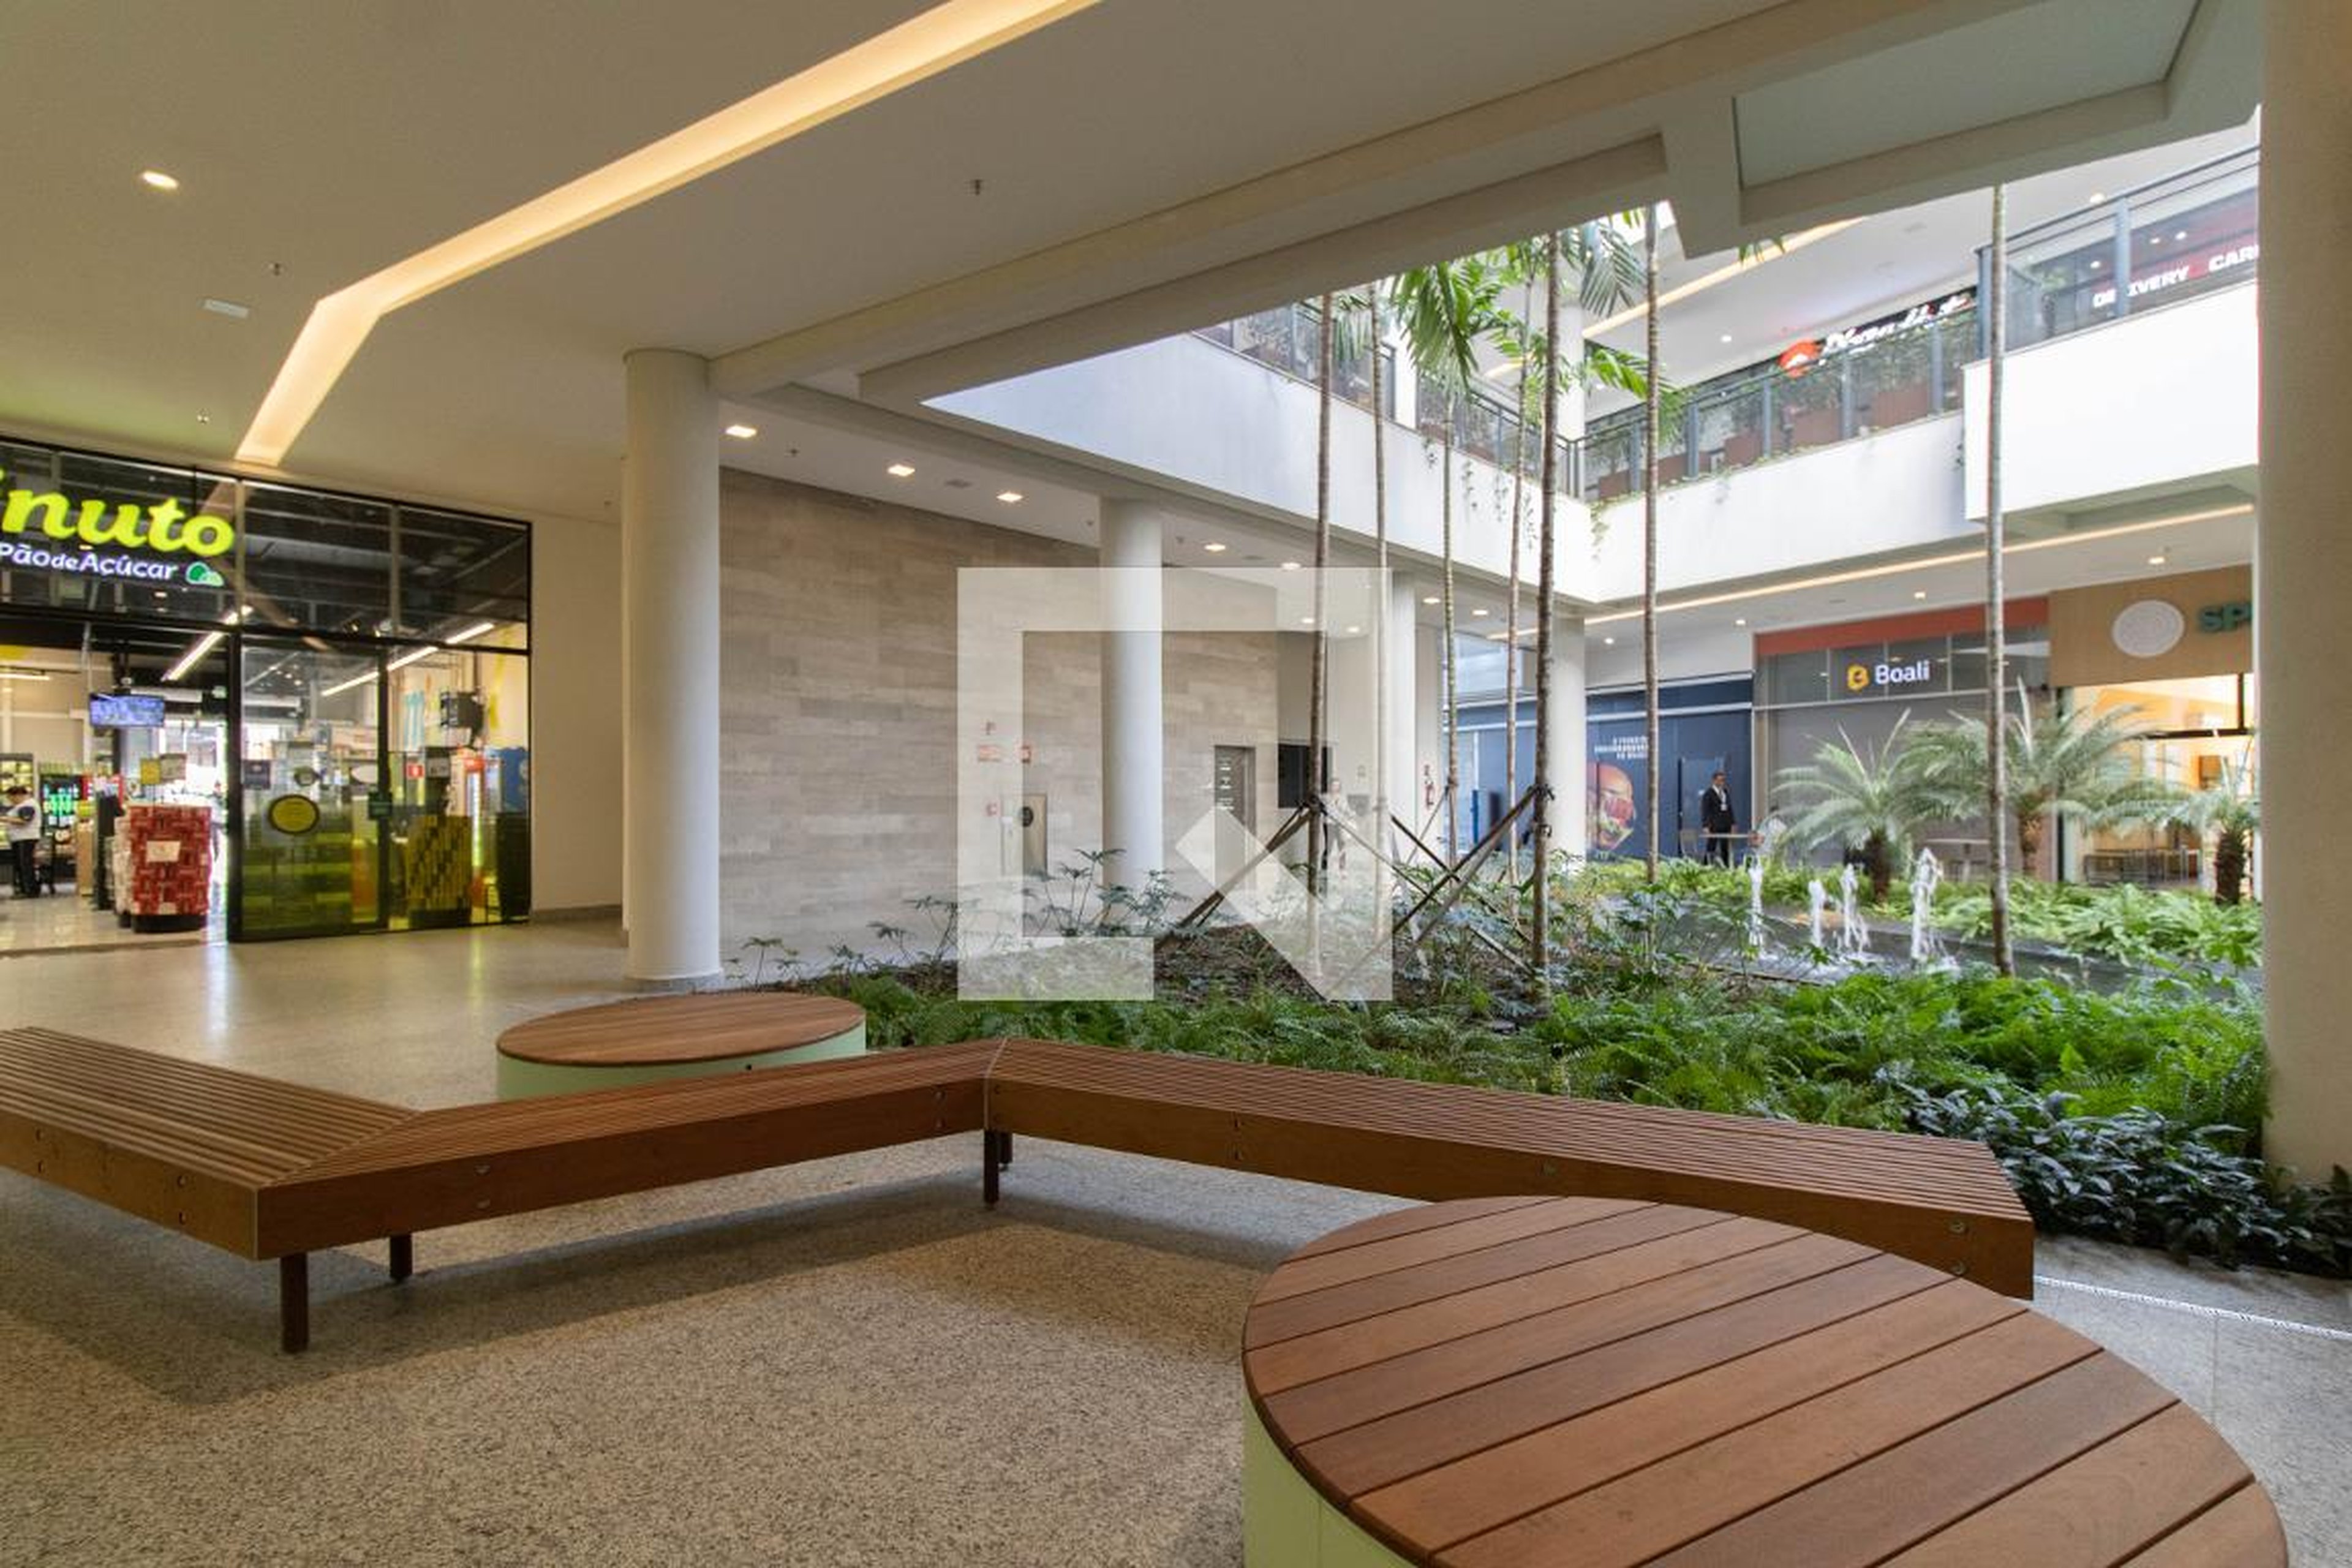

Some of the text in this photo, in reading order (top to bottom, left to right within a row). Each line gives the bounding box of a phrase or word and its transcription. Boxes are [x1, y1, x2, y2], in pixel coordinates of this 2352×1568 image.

[2092, 266, 2190, 307] DEIVERY
[0, 469, 235, 557] nuto
[1875, 659, 1930, 685] Boali
